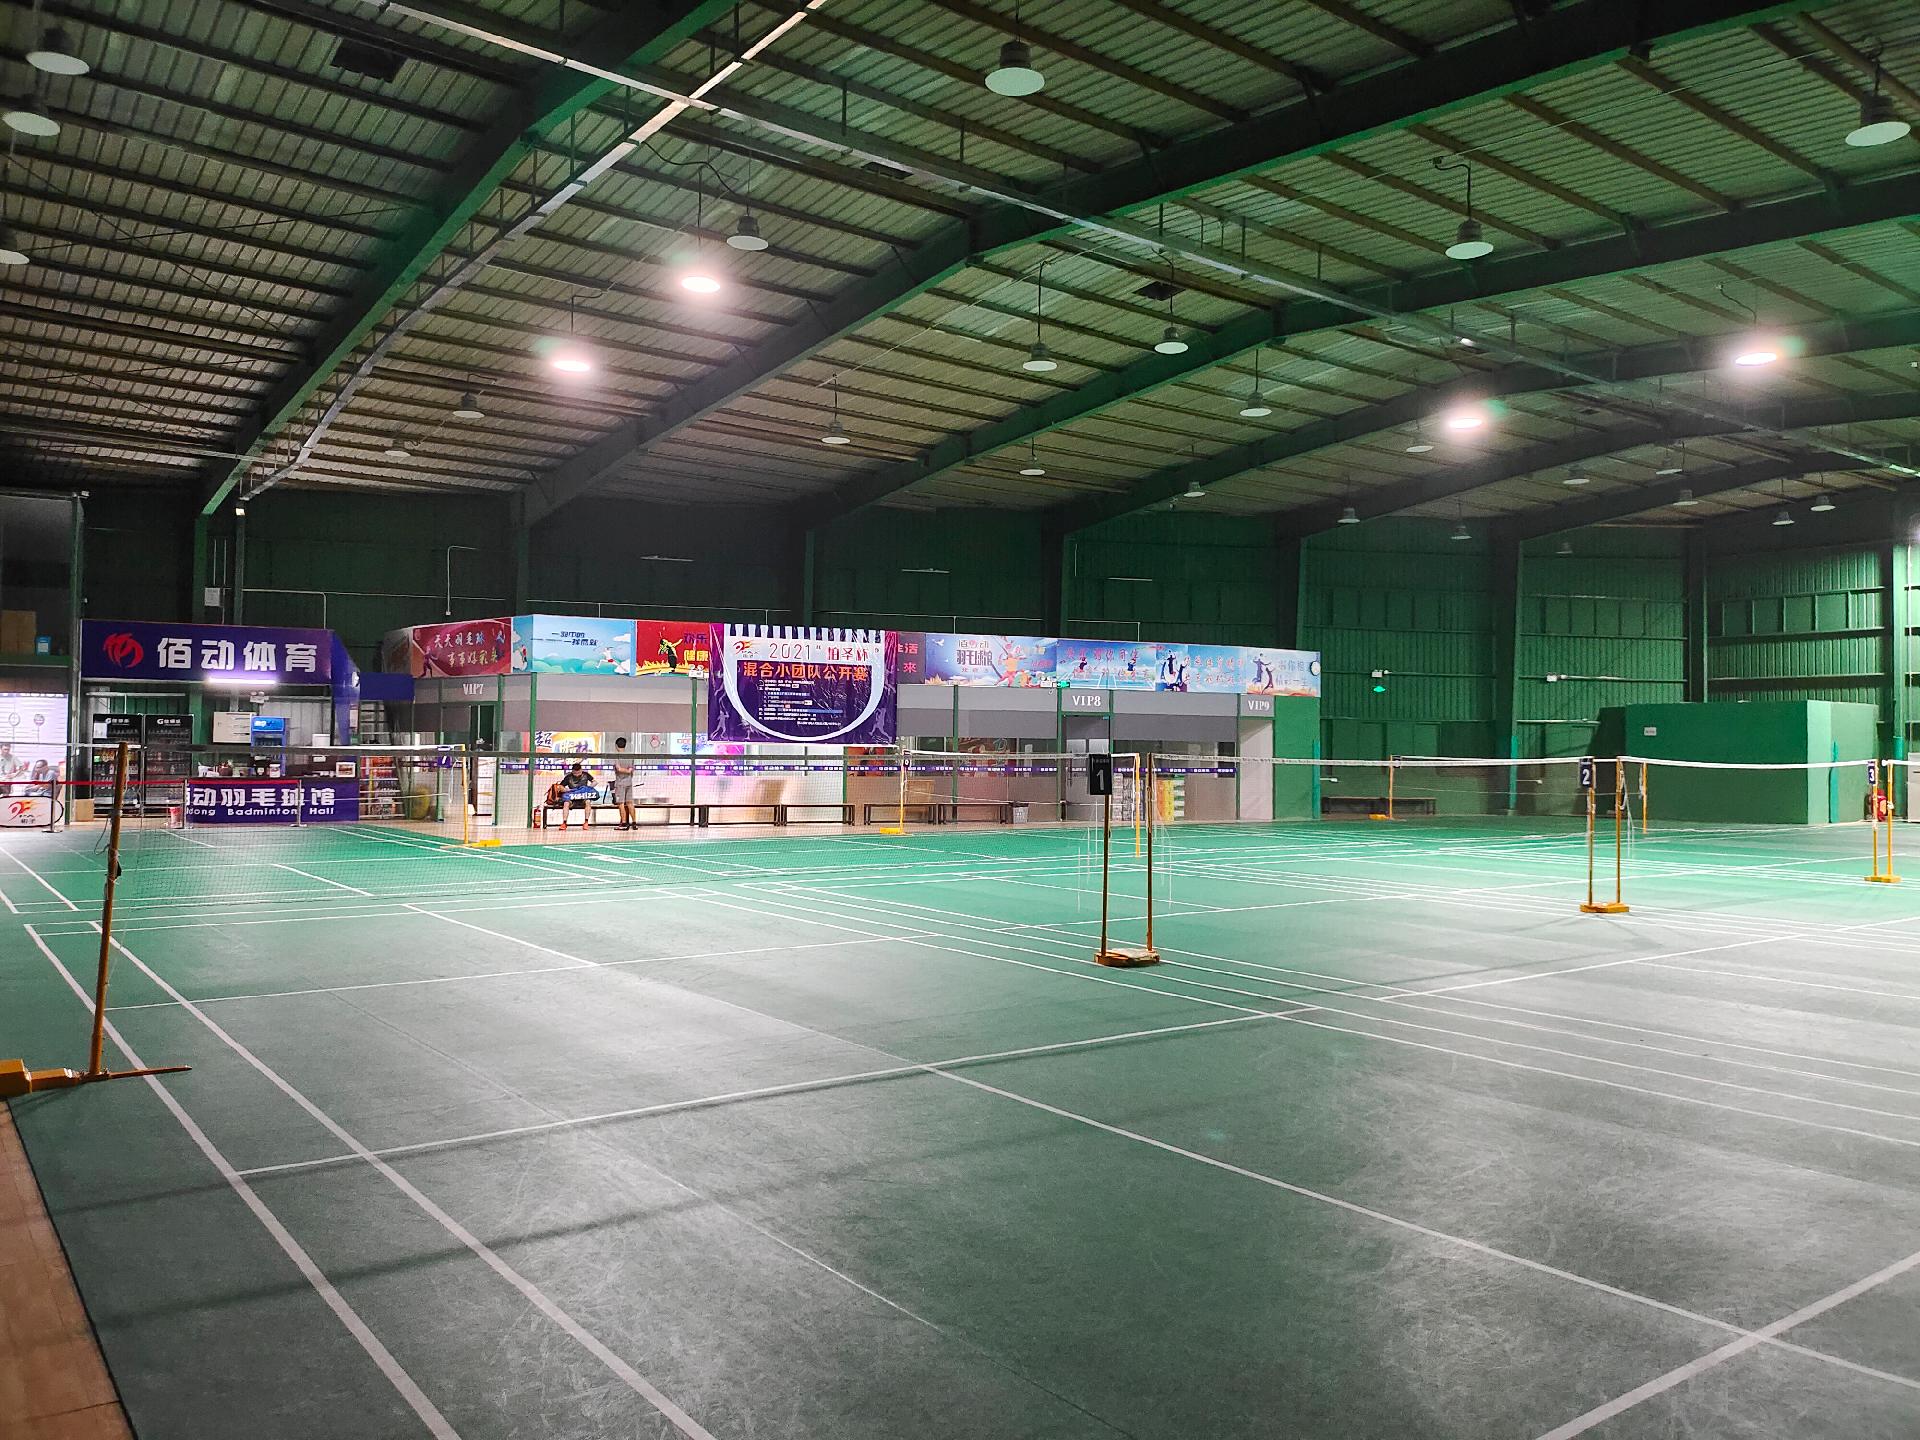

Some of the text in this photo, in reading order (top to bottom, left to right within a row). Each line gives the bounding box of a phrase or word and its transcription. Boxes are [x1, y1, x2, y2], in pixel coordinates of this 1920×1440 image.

[684, 633, 707, 644] 欢乐
[157, 637, 317, 673] 佰动体育
[684, 650, 708, 662] 健康
[769, 643, 811, 660] 2021
[743, 662, 868, 681] 混合小团队公开赛
[463, 683, 484, 695] VIP7
[1072, 695, 1101, 707] VIP8
[1248, 700, 1270, 711] VIP9
[1096, 769, 1105, 791] 1
[1582, 768, 1591, 785] 2
[1869, 768, 1875, 782] 3
[227, 807, 298, 816] Badminton
[309, 806, 335, 816] Hall
